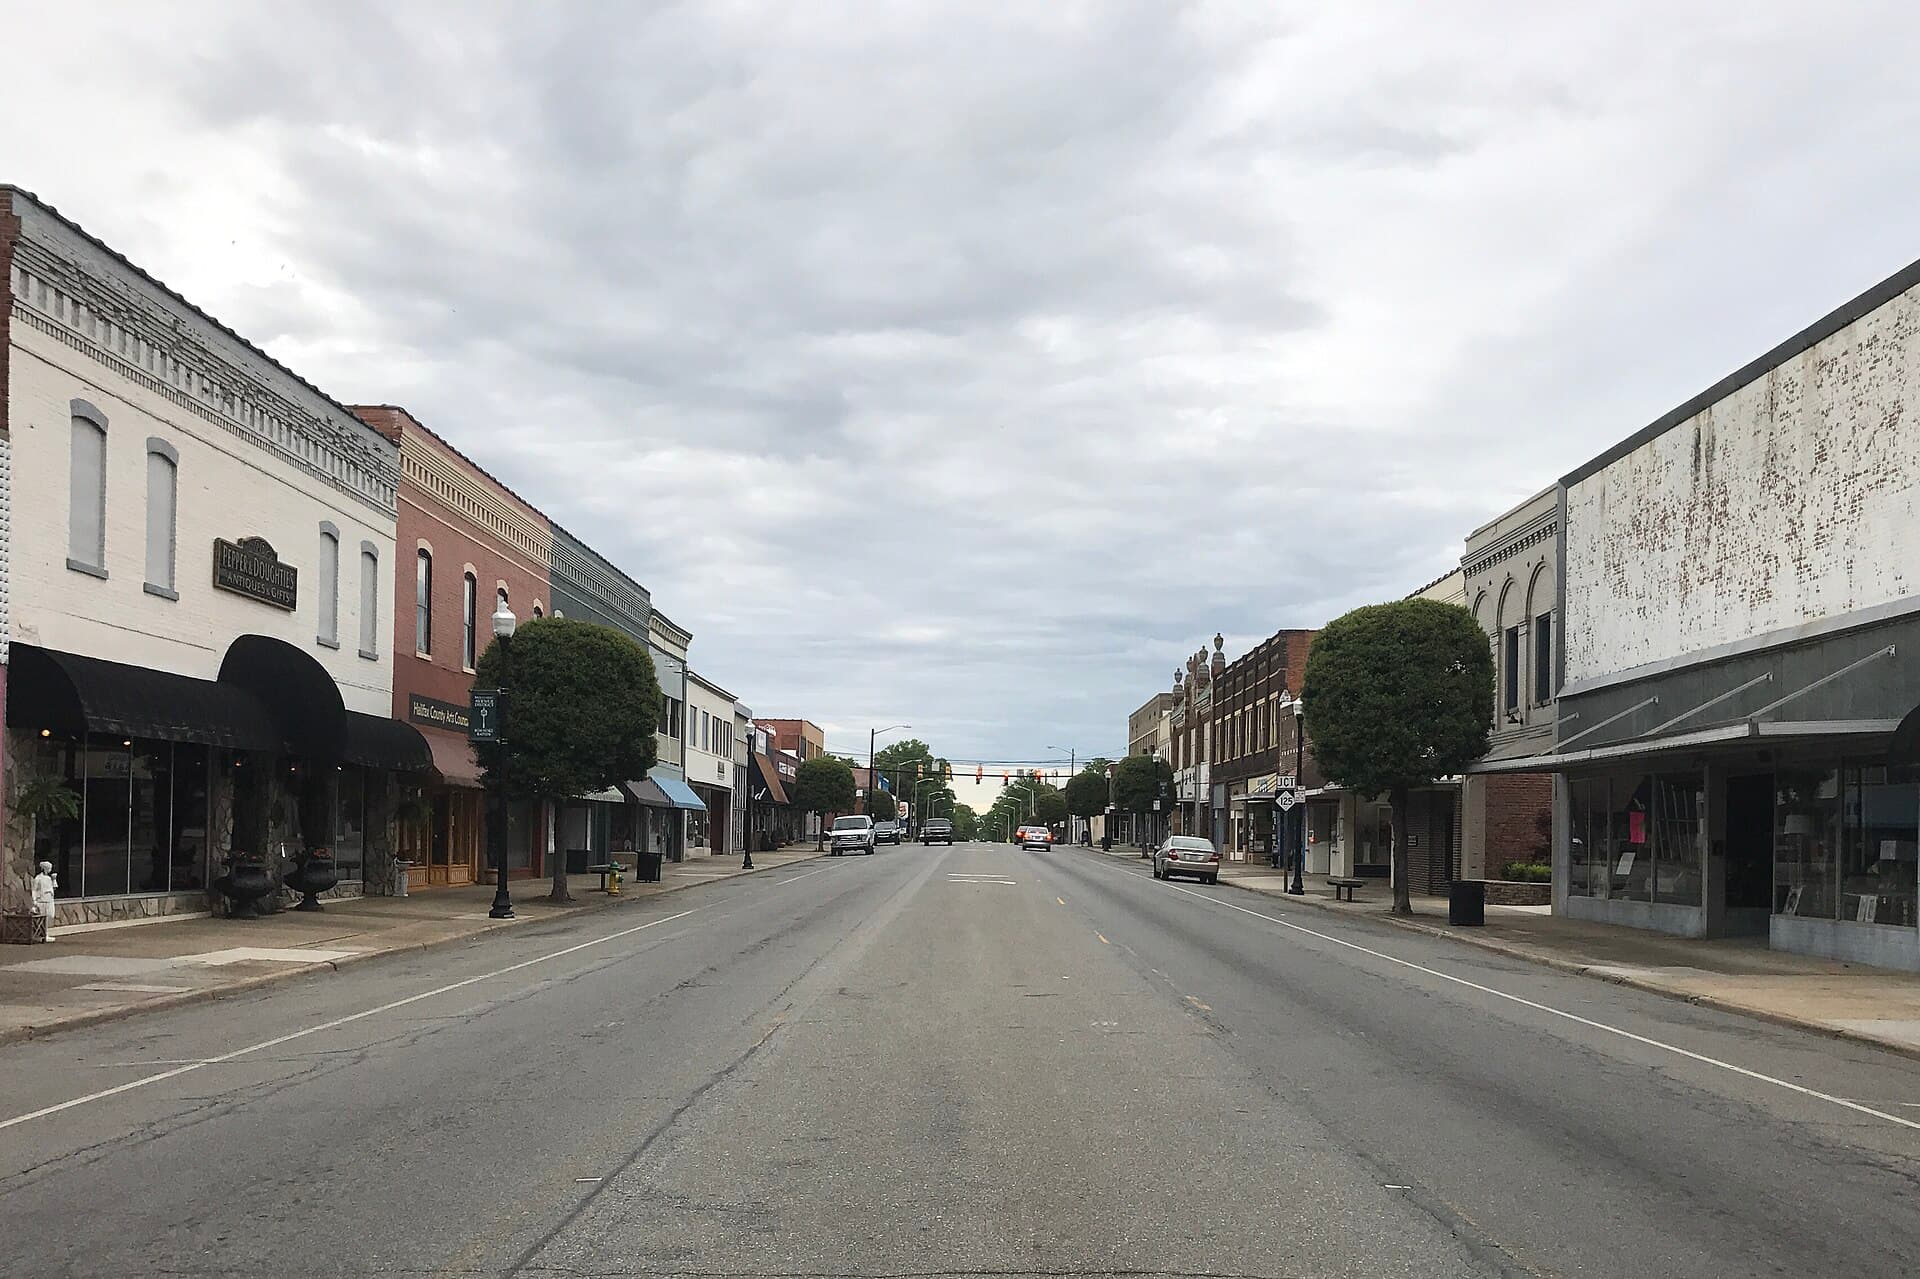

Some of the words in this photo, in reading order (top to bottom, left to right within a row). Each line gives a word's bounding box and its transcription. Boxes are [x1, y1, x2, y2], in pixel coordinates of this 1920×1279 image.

[223, 545, 248, 575] PEPPER
[226, 572, 265, 594] ANTIQUES
[271, 587, 290, 603] GIFTS
[413, 701, 430, 718] Halifax
[430, 705, 446, 725] County
[446, 710, 454, 723] Arts
[1277, 778, 1295, 787] JCT
[1280, 797, 1293, 806] 125
